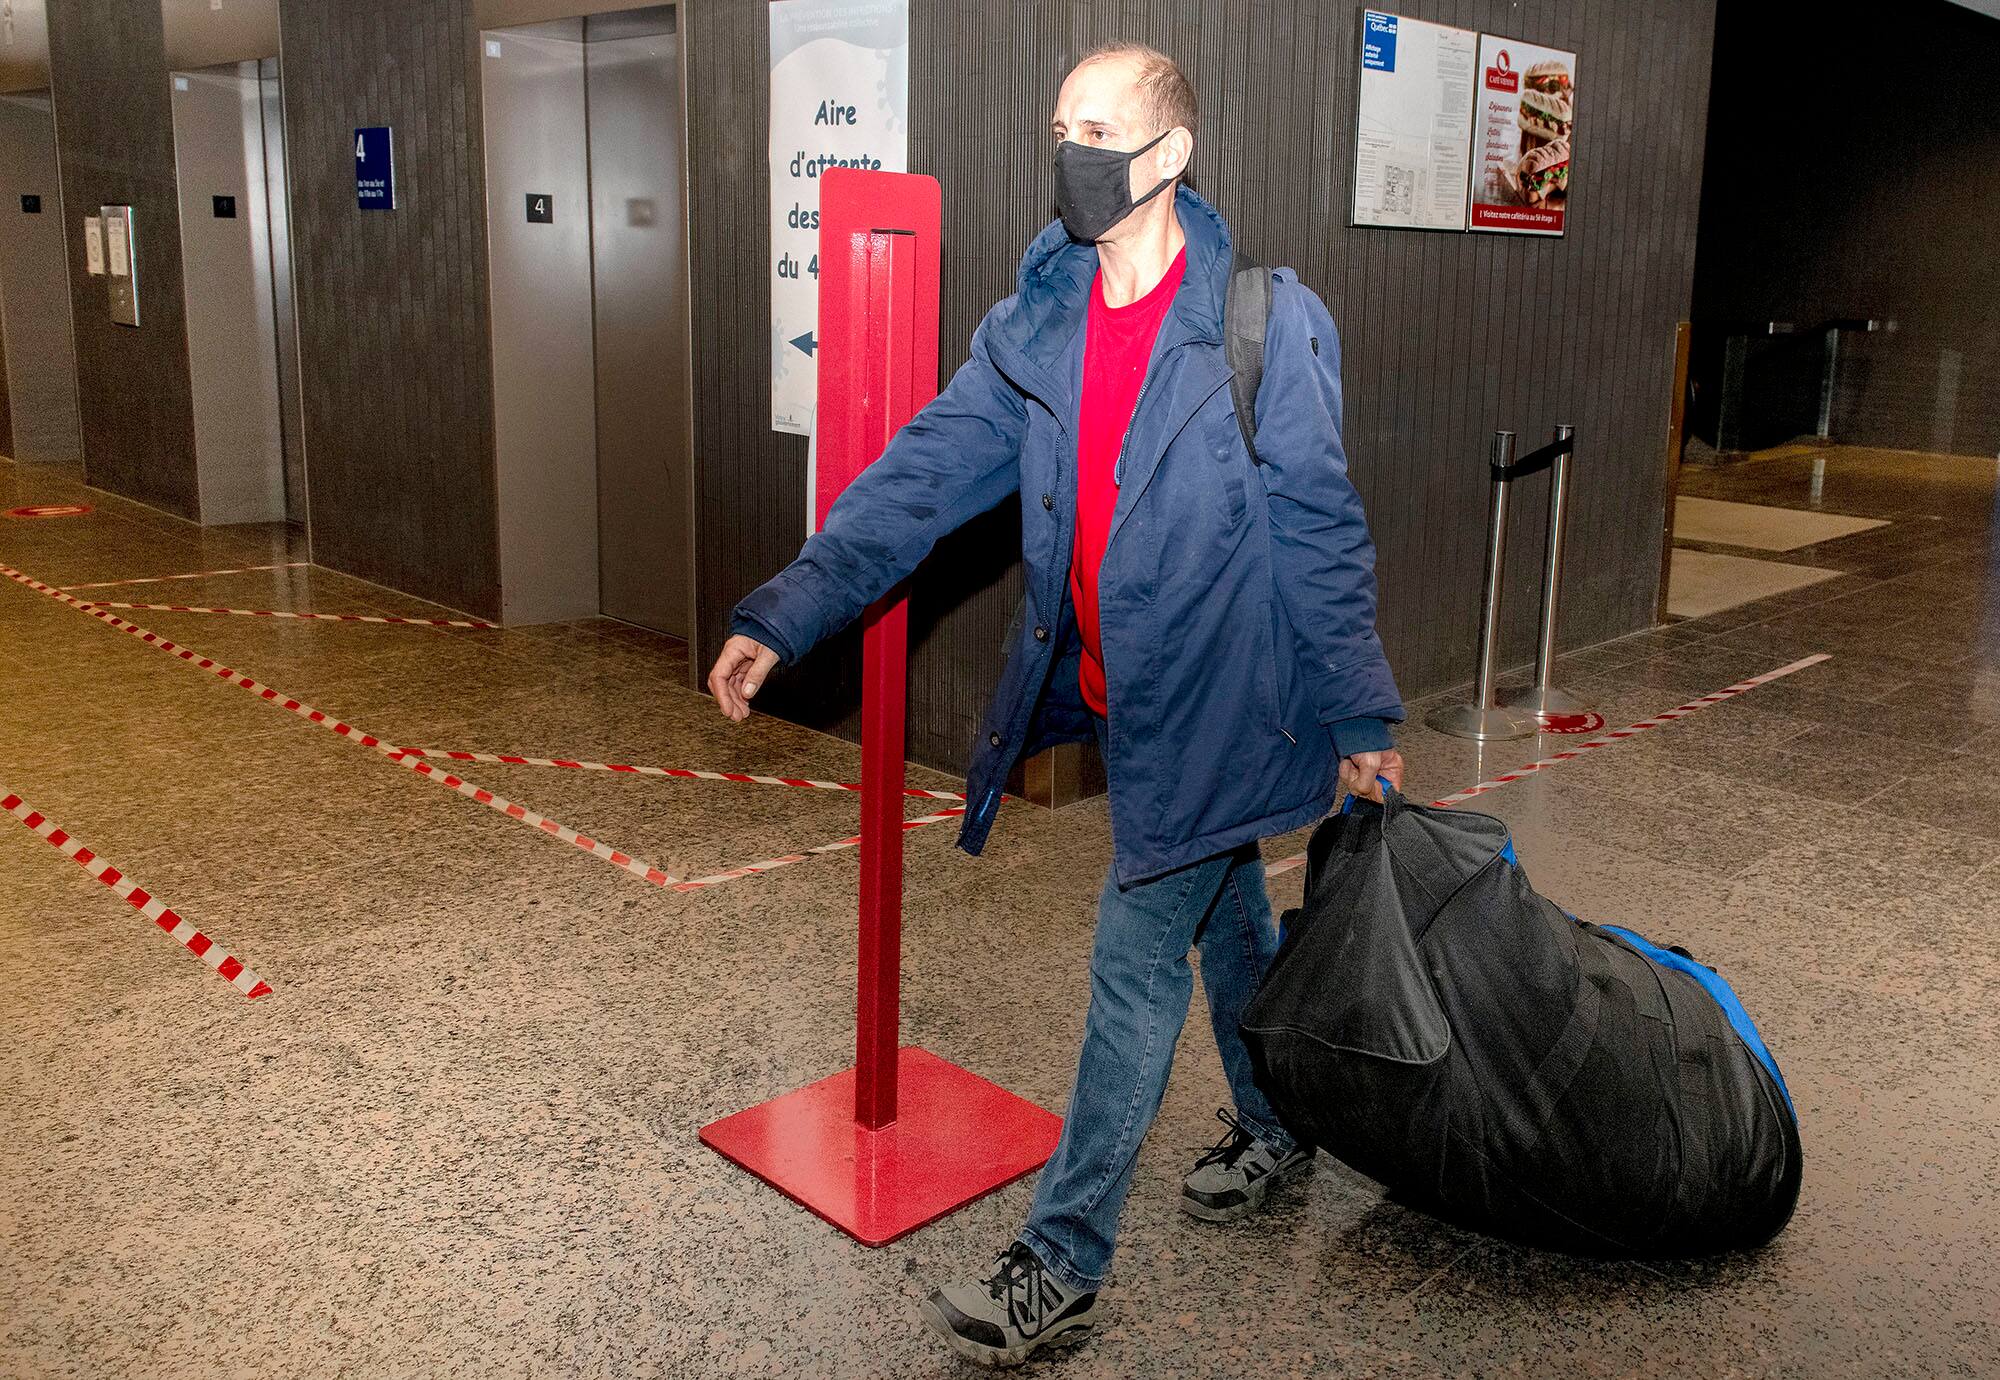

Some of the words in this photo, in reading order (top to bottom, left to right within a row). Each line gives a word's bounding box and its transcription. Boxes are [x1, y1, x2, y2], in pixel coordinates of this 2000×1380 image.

[815, 99, 857, 126] Aire
[356, 134, 366, 163] 4
[534, 198, 545, 214] 4
[788, 202, 819, 229] des
[1483, 209, 1498, 218] Visitez
[777, 252, 799, 280] du
